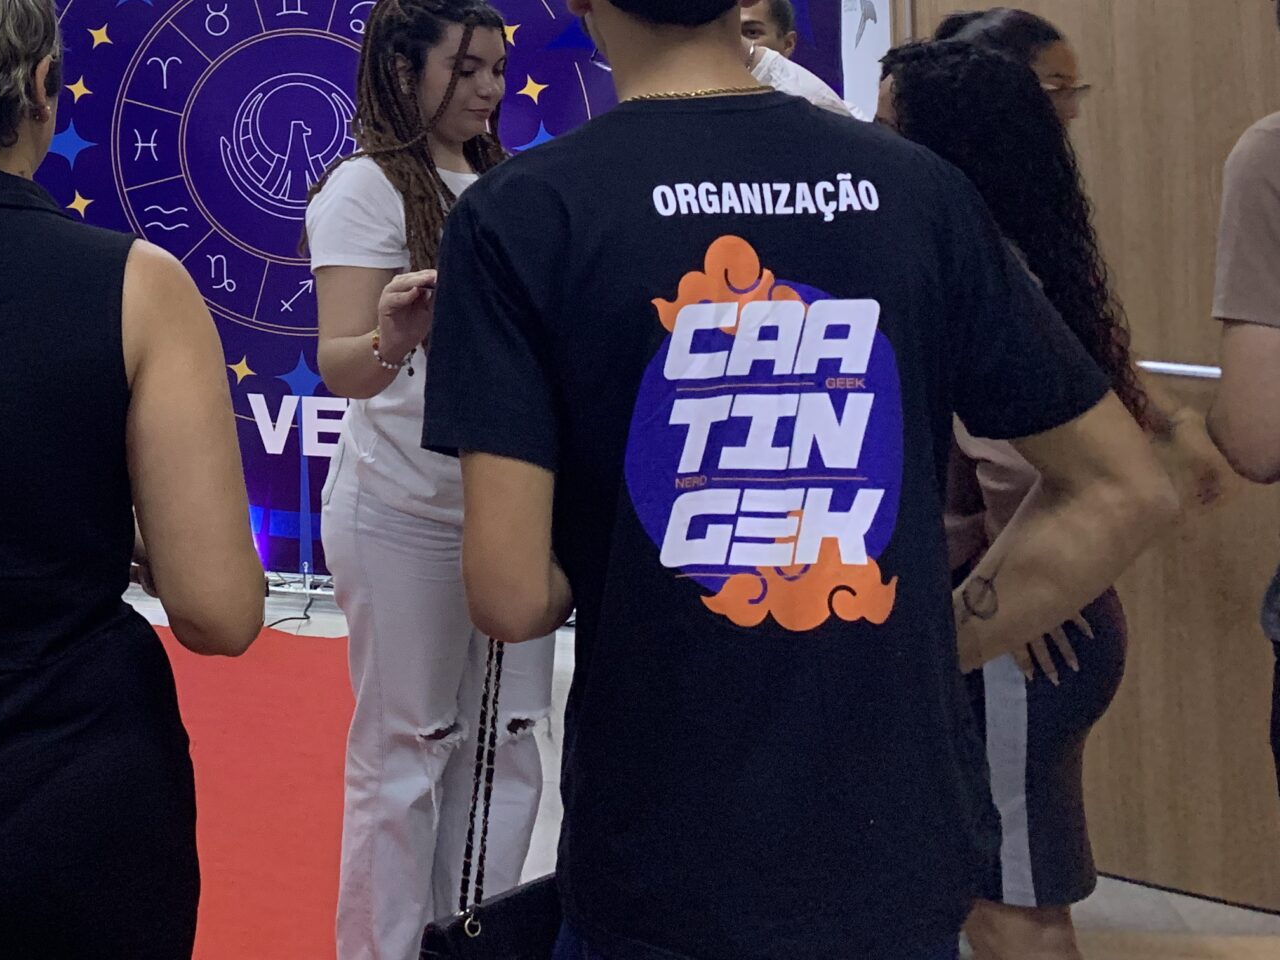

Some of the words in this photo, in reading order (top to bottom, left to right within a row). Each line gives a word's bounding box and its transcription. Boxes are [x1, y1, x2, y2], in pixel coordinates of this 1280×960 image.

[652, 173, 880, 222] ORGANIZAÇÃO
[663, 298, 881, 380] CAA
[825, 377, 866, 390] GEEK
[668, 392, 875, 473] TIN
[675, 475, 708, 489] NERD
